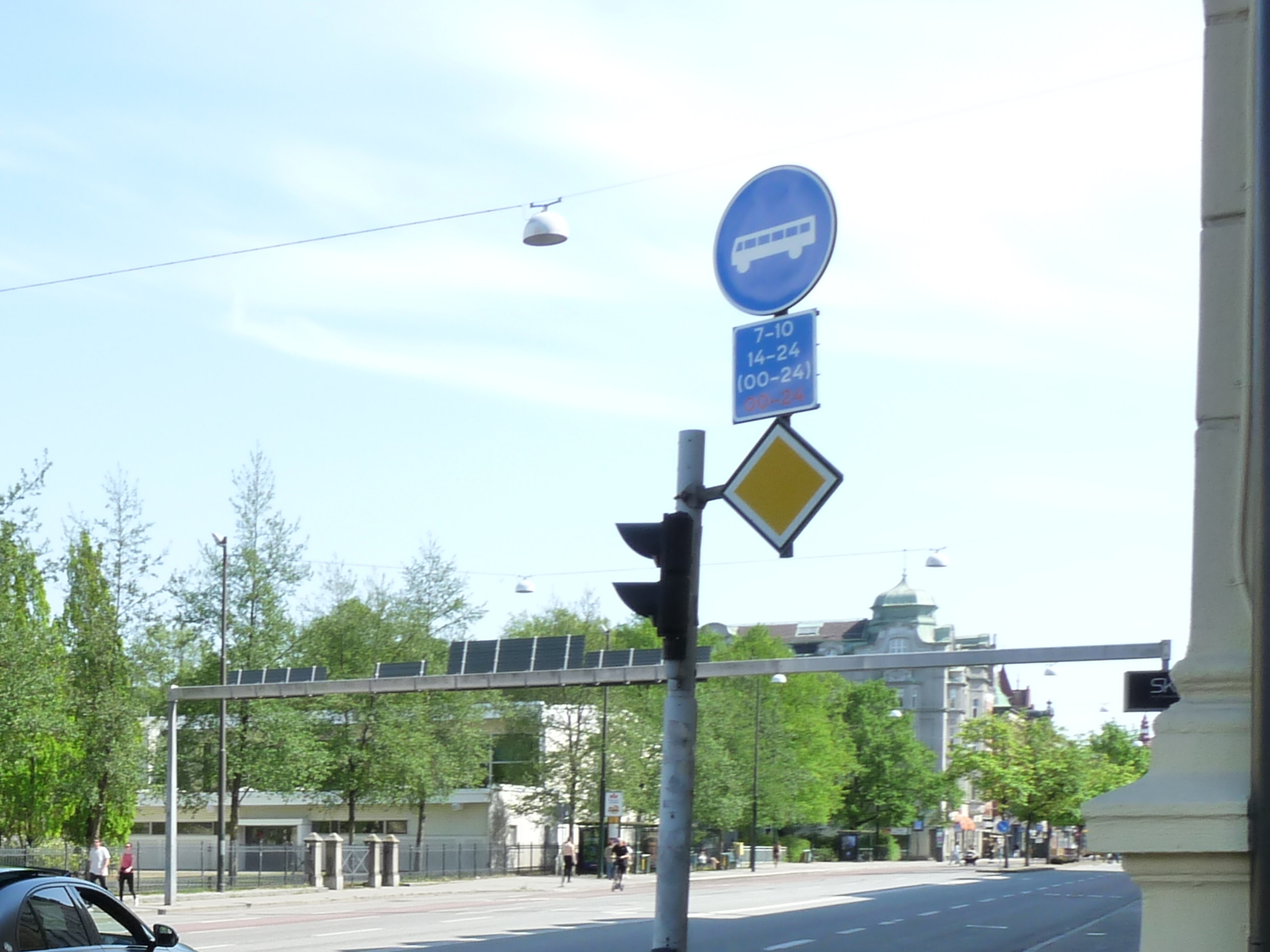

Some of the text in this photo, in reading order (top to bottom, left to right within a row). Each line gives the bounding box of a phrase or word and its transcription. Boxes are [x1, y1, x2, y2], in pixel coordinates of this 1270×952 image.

[754, 320, 794, 343] 7-10
[747, 341, 801, 367] 14-24
[737, 360, 812, 393] (00-24)
[743, 387, 805, 412] 00-24
